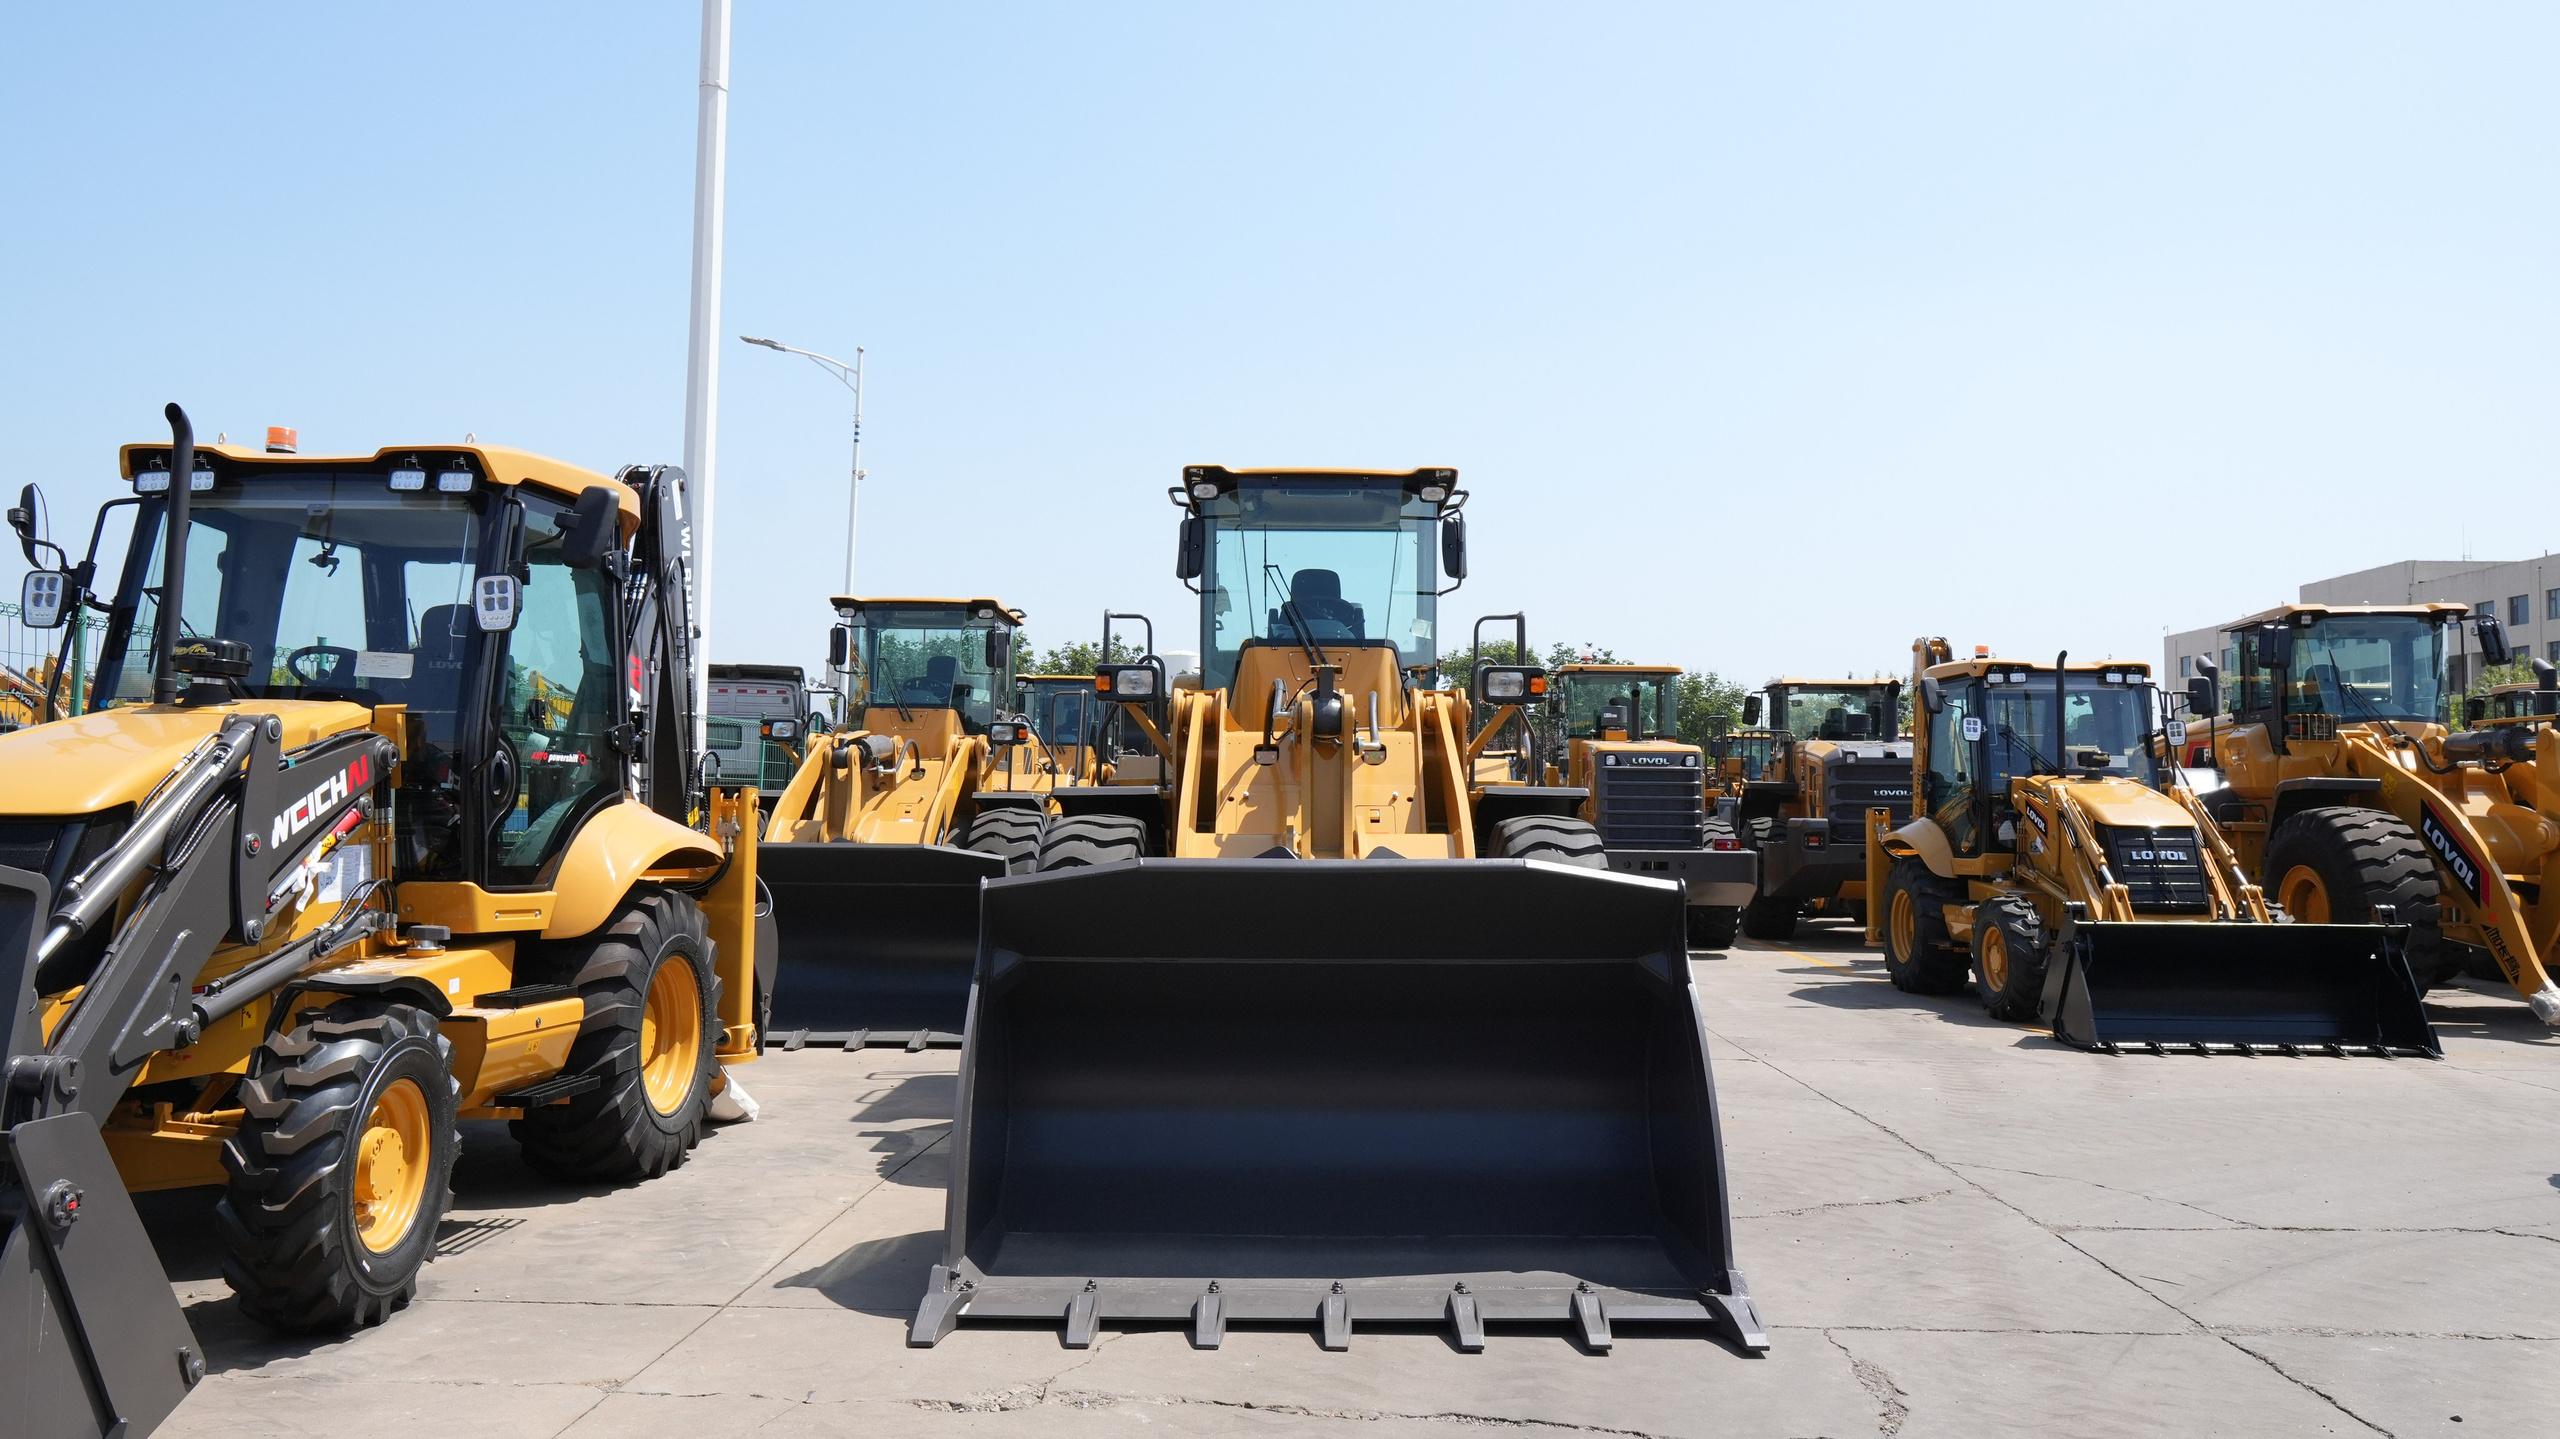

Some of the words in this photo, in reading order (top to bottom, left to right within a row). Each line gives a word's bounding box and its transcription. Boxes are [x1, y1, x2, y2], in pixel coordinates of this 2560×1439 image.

[531, 751, 548, 760] AUTO
[548, 753, 579, 763] powershift
[1632, 757, 1670, 765] LOVOL
[271, 754, 369, 849] WEICHAI
[2026, 806, 2046, 832] LOVOL
[2423, 817, 2474, 891] LOVOL
